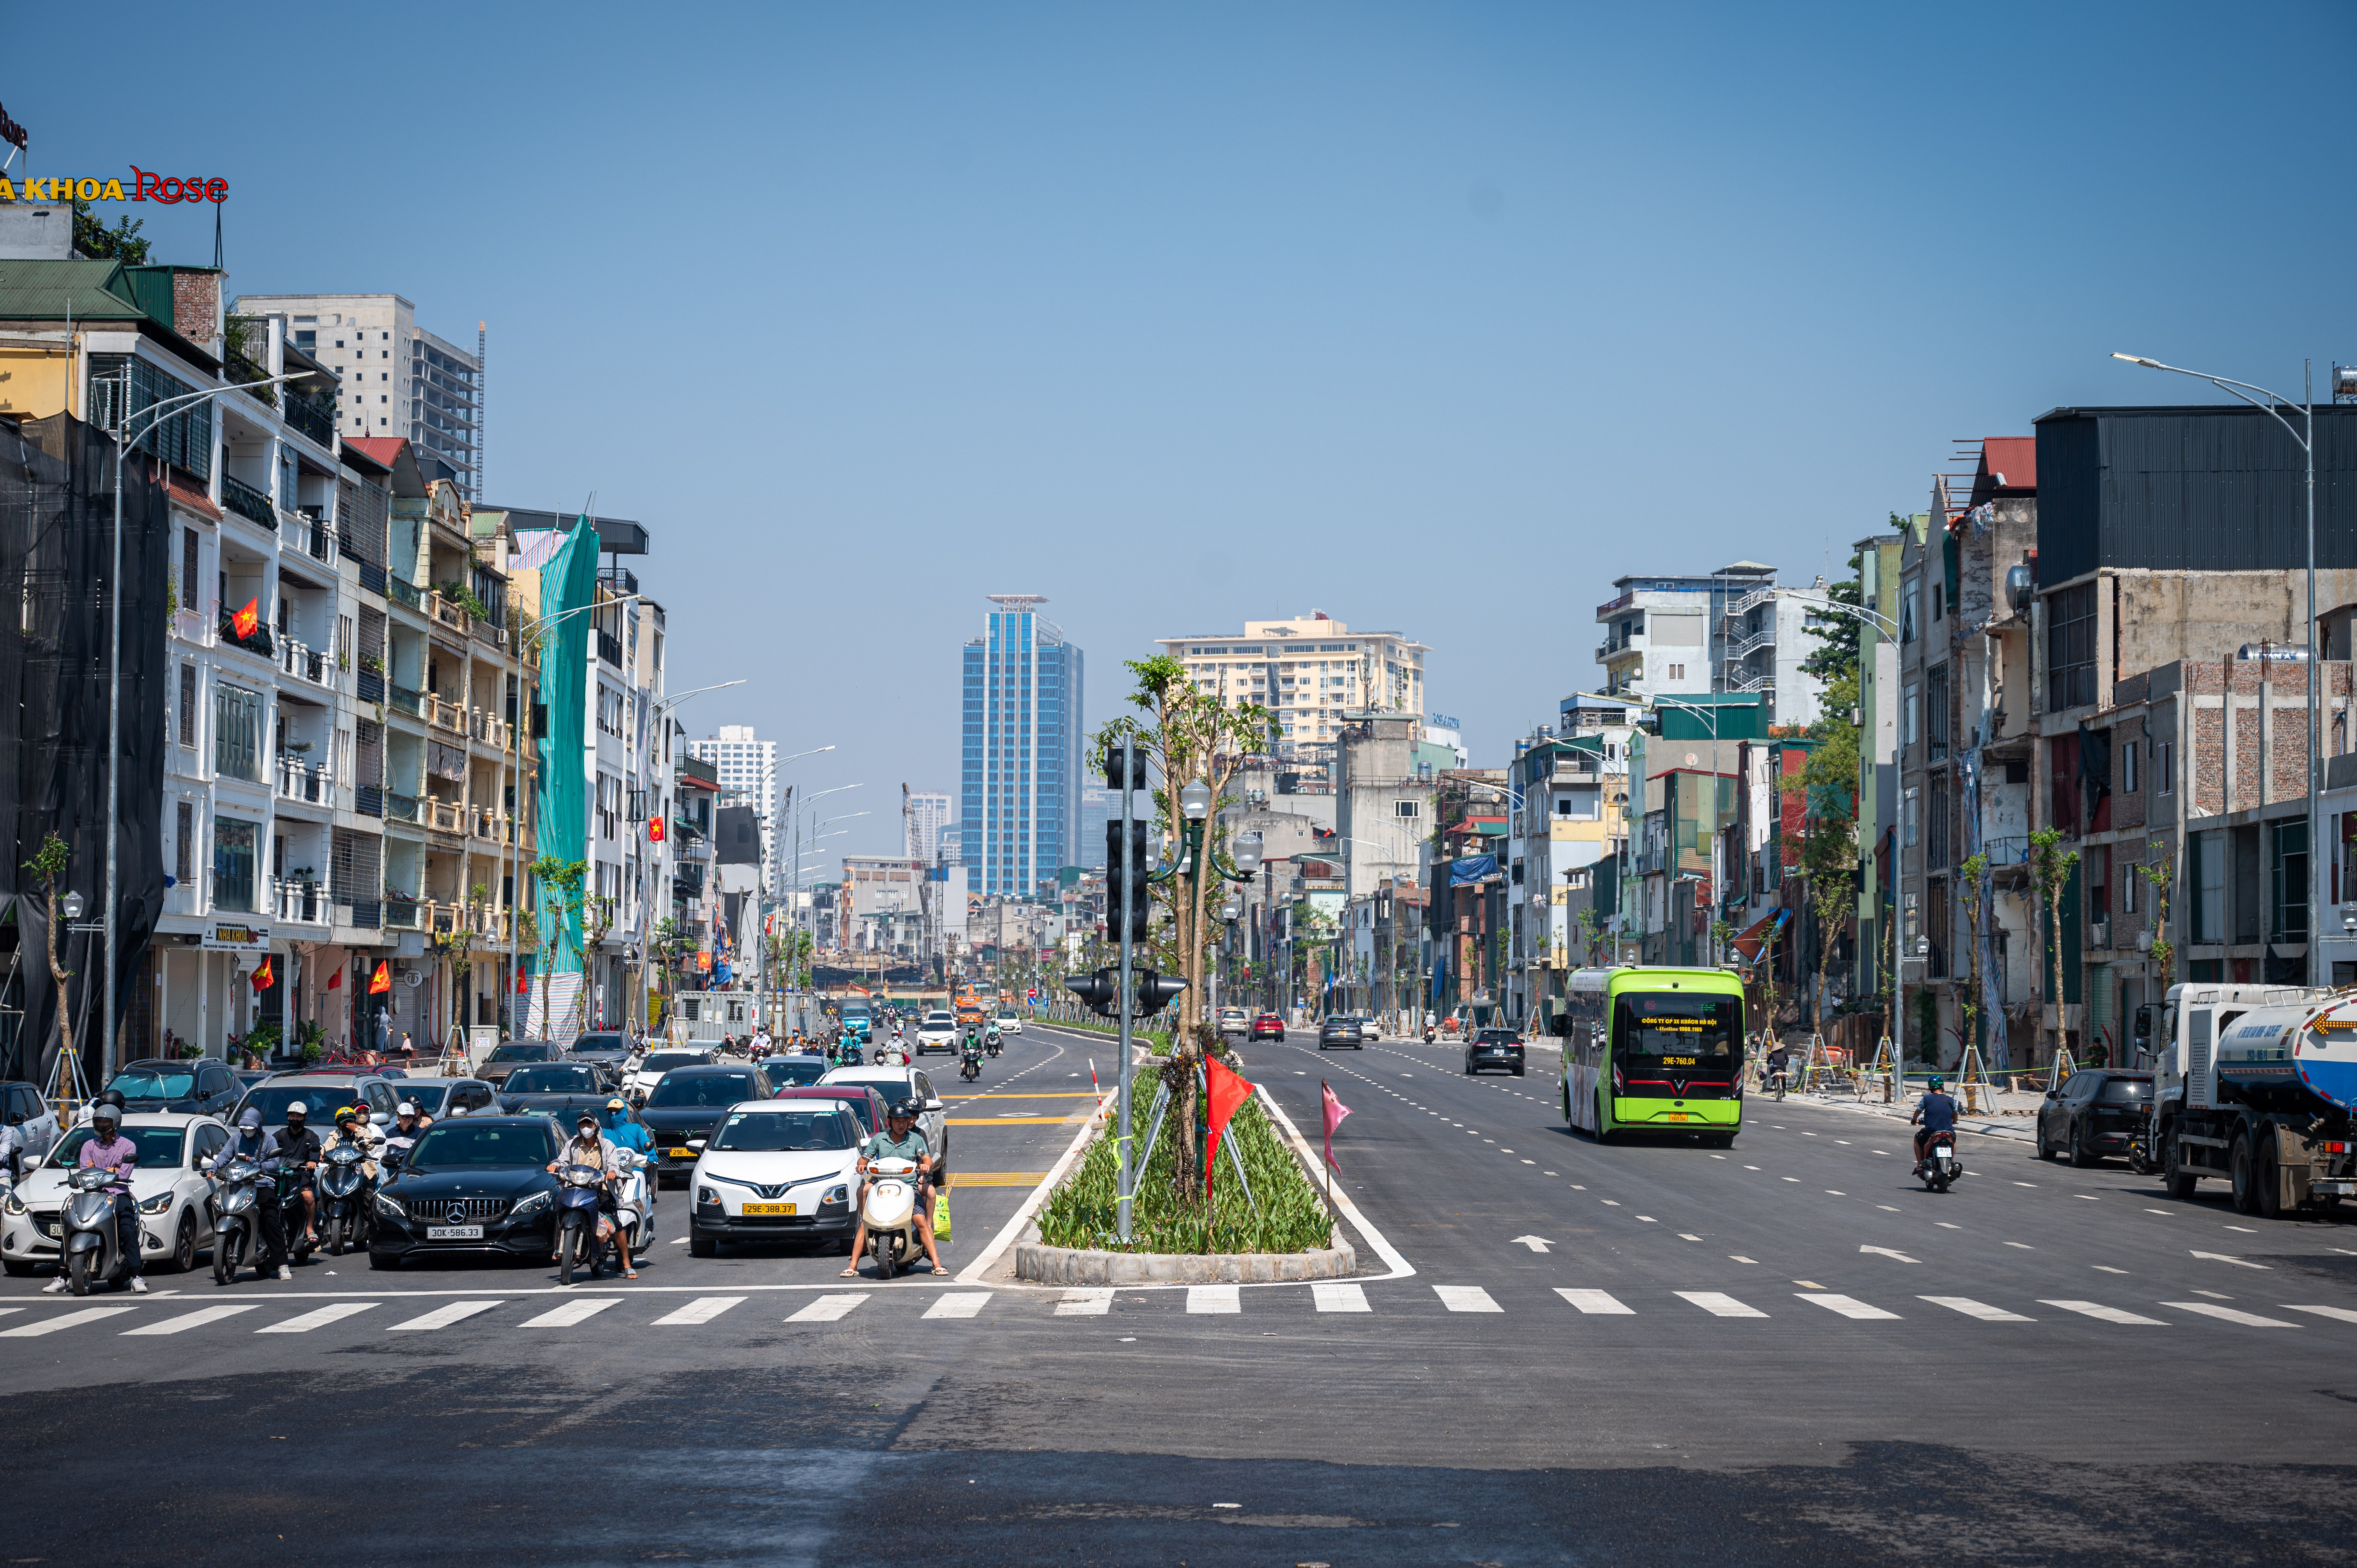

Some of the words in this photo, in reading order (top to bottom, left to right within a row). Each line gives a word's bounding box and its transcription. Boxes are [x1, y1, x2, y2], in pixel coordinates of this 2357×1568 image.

[24, 177, 126, 201] KHOA
[218, 928, 230, 941] NHA
[231, 929, 247, 942] KHOA
[1663, 1057, 1695, 1065] 29E-760.04
[432, 1229, 478, 1237] 30K-586.33
